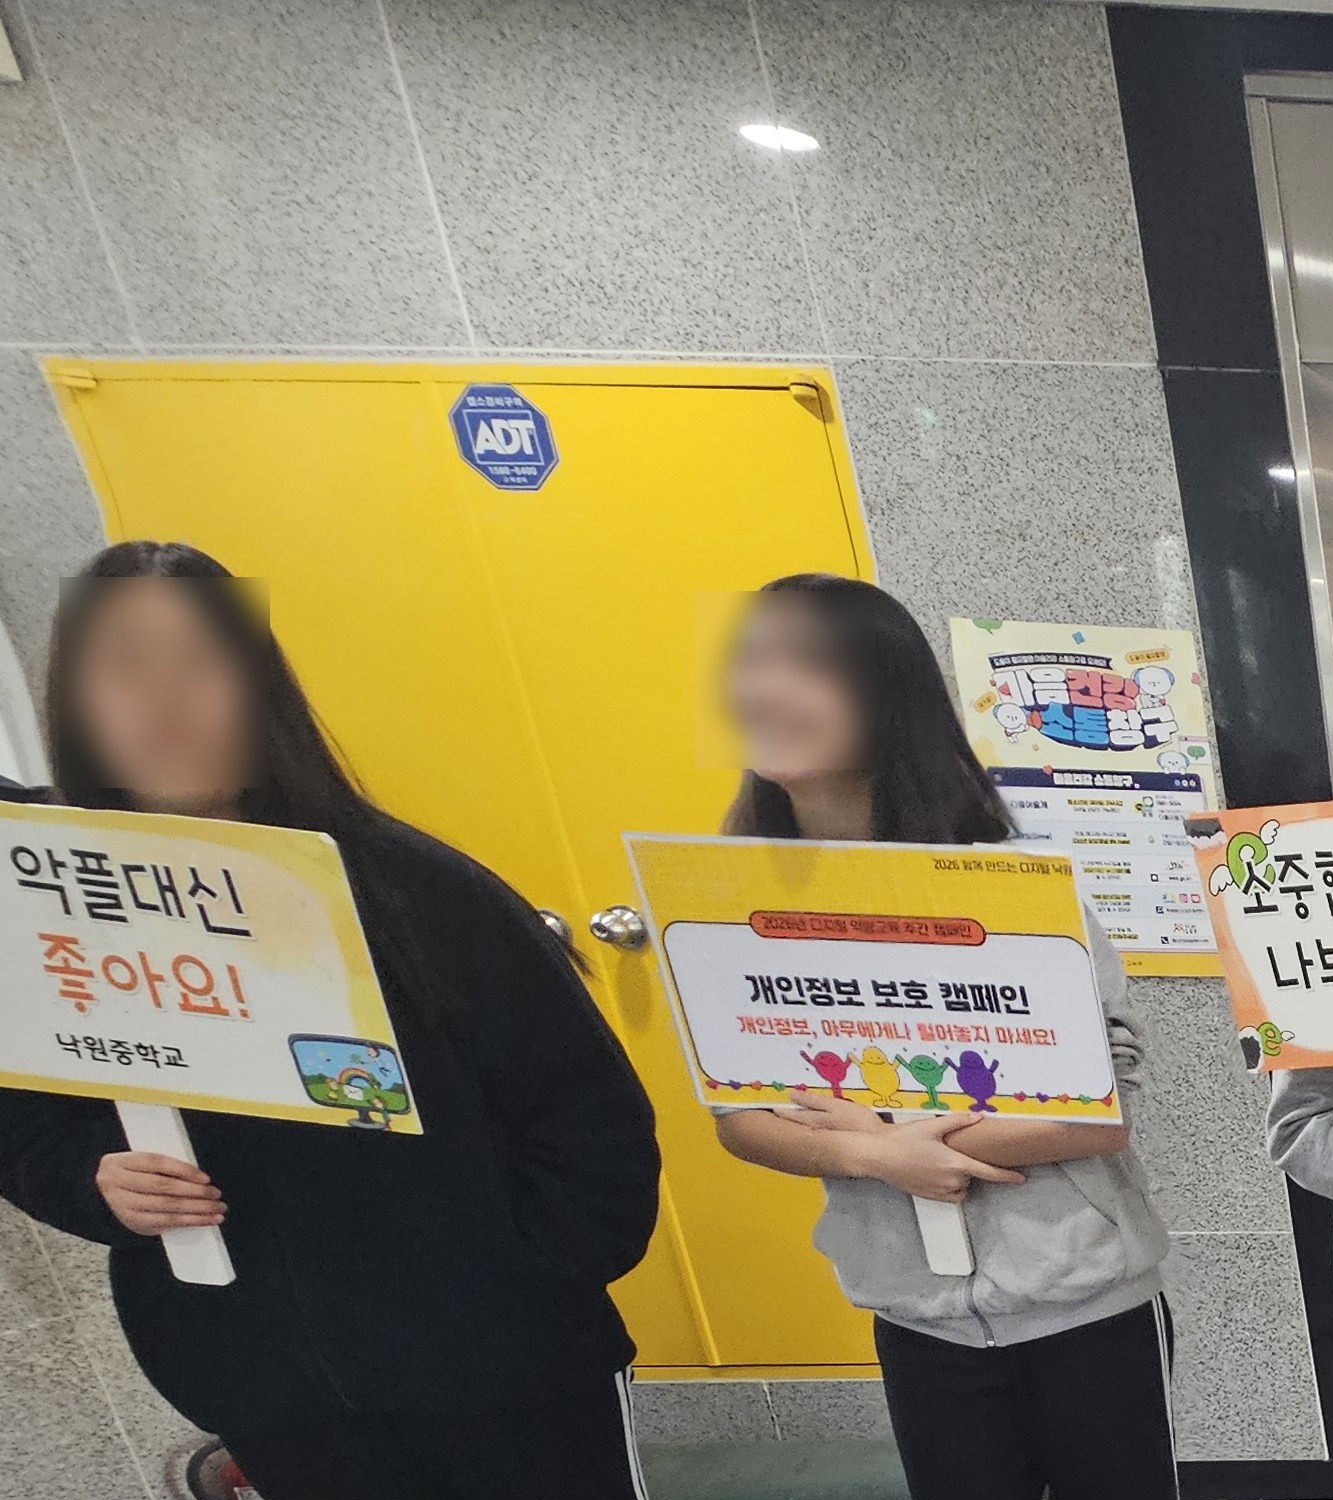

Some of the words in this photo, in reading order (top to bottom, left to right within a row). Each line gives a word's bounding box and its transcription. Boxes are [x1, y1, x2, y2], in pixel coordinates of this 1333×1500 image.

[476, 418, 535, 455] ADT
[933, 859, 960, 871] 2026
[10, 845, 253, 938] 악플대신
[37, 932, 252, 1020] 좋아요!
[744, 973, 866, 1008] 개인정보
[872, 979, 934, 1010] 보호
[939, 982, 1032, 1016] 캠페인
[736, 1015, 818, 1041] 개인정보,
[820, 1019, 910, 1044] 아무에게나
[918, 1022, 991, 1045] 털어놓지
[996, 1026, 1058, 1047] 마세요!
[56, 1033, 190, 1069] 낙원중학교
